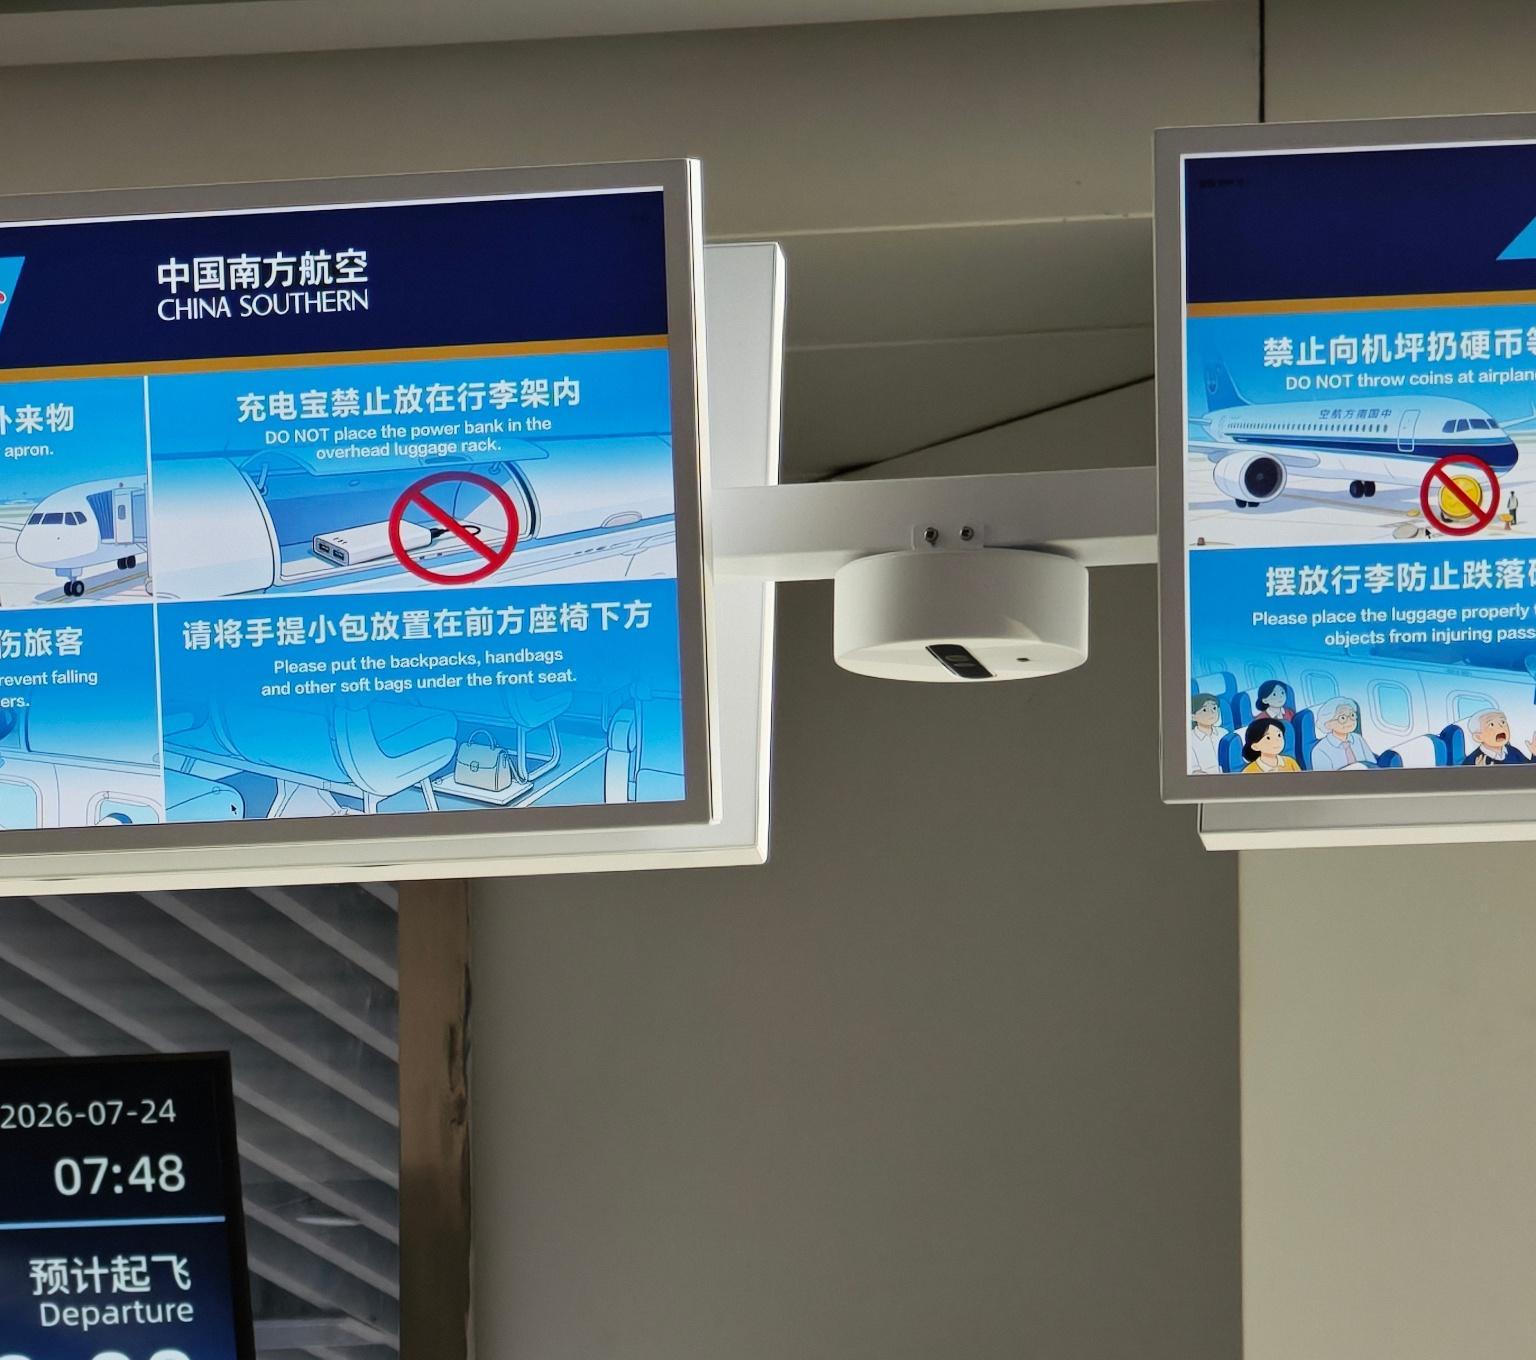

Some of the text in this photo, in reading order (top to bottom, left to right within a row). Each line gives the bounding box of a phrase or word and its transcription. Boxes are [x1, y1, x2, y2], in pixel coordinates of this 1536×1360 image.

[158, 247, 368, 294] 中国南方航空
[158, 289, 368, 321] CHINA SOUTHERN
[1286, 367, 1536, 390] DO NOT throw coins at airplan
[237, 376, 579, 422] 充电宝禁止放在行李架内
[266, 416, 551, 446] DO NOT place the power bank in the
[5, 445, 53, 460] apron.
[317, 439, 501, 460] overhead luggage rack.
[1266, 557, 1536, 597] 摆放行李防止跌落
[183, 599, 651, 650] 请将手提小包放置在前方座椅下方
[1253, 603, 1529, 627] Please place the luggage properly
[1325, 630, 1385, 648] objects
[1389, 629, 1427, 643] from
[1432, 627, 1492, 645] injuring
[275, 648, 563, 674] Please put the backpacks, handbags
[52, 669, 97, 686] falling
[262, 668, 576, 696] and other soft bags under the front seat.
[1, 1098, 176, 1129] 2026-07-24
[55, 1154, 185, 1196] 07:48
[29, 1255, 192, 1297] 预计起飞
[40, 1300, 193, 1331] Departure
